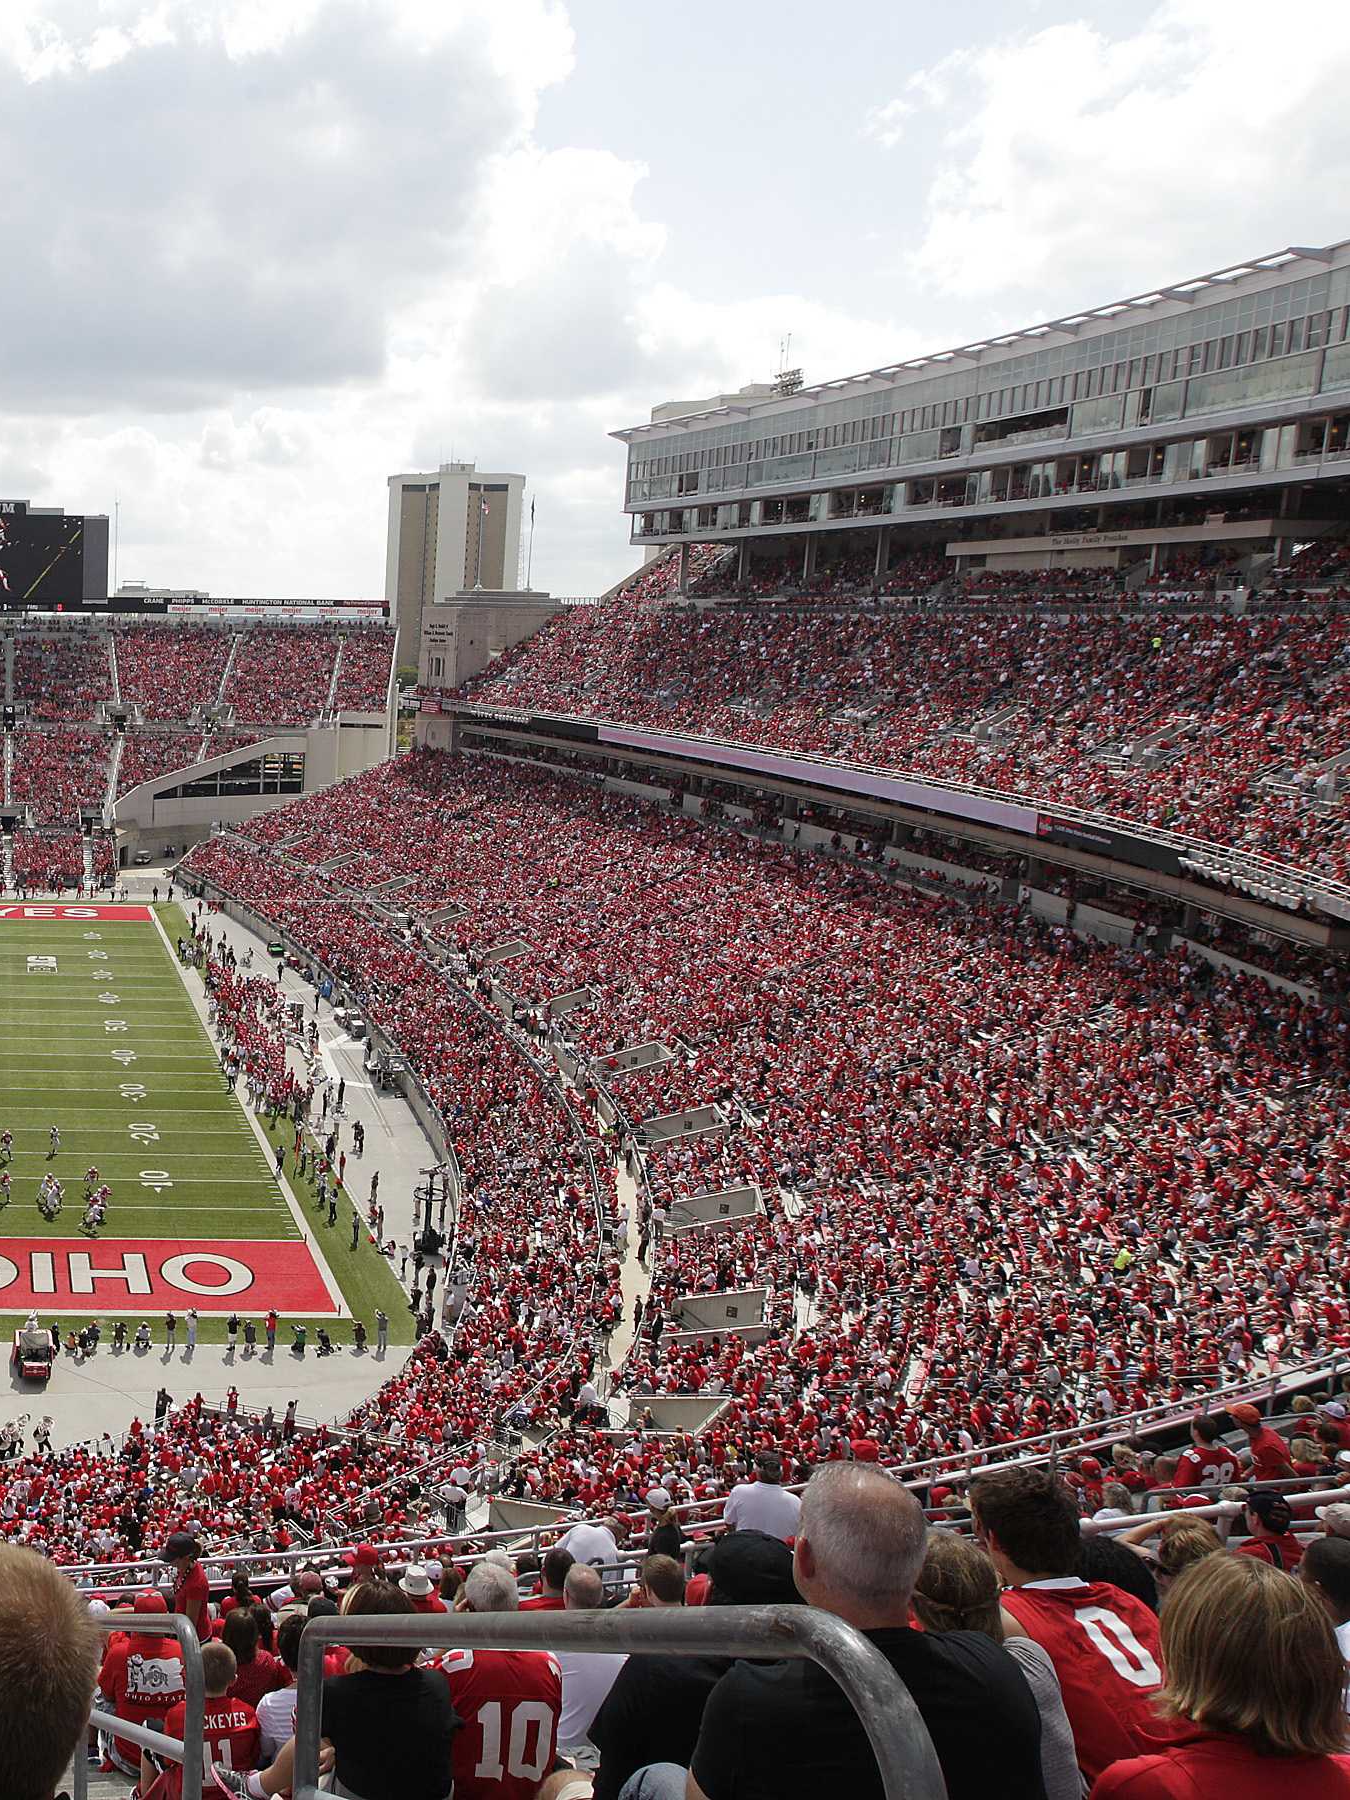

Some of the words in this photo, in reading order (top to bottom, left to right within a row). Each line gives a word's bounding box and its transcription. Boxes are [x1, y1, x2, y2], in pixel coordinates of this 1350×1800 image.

[245, 606, 265, 614] meijer
[319, 607, 340, 615] meijer
[357, 607, 378, 615] meijer
[104, 1020, 128, 1032] 50
[111, 1049, 137, 1062] 40
[119, 1083, 147, 1098] 30
[128, 1123, 160, 1140] 20
[139, 1170, 174, 1187] 10
[1201, 1462, 1235, 1486] 28
[1074, 1605, 1162, 1688] 0
[124, 1693, 151, 1702] OHIO
[474, 1700, 555, 1783] 10
